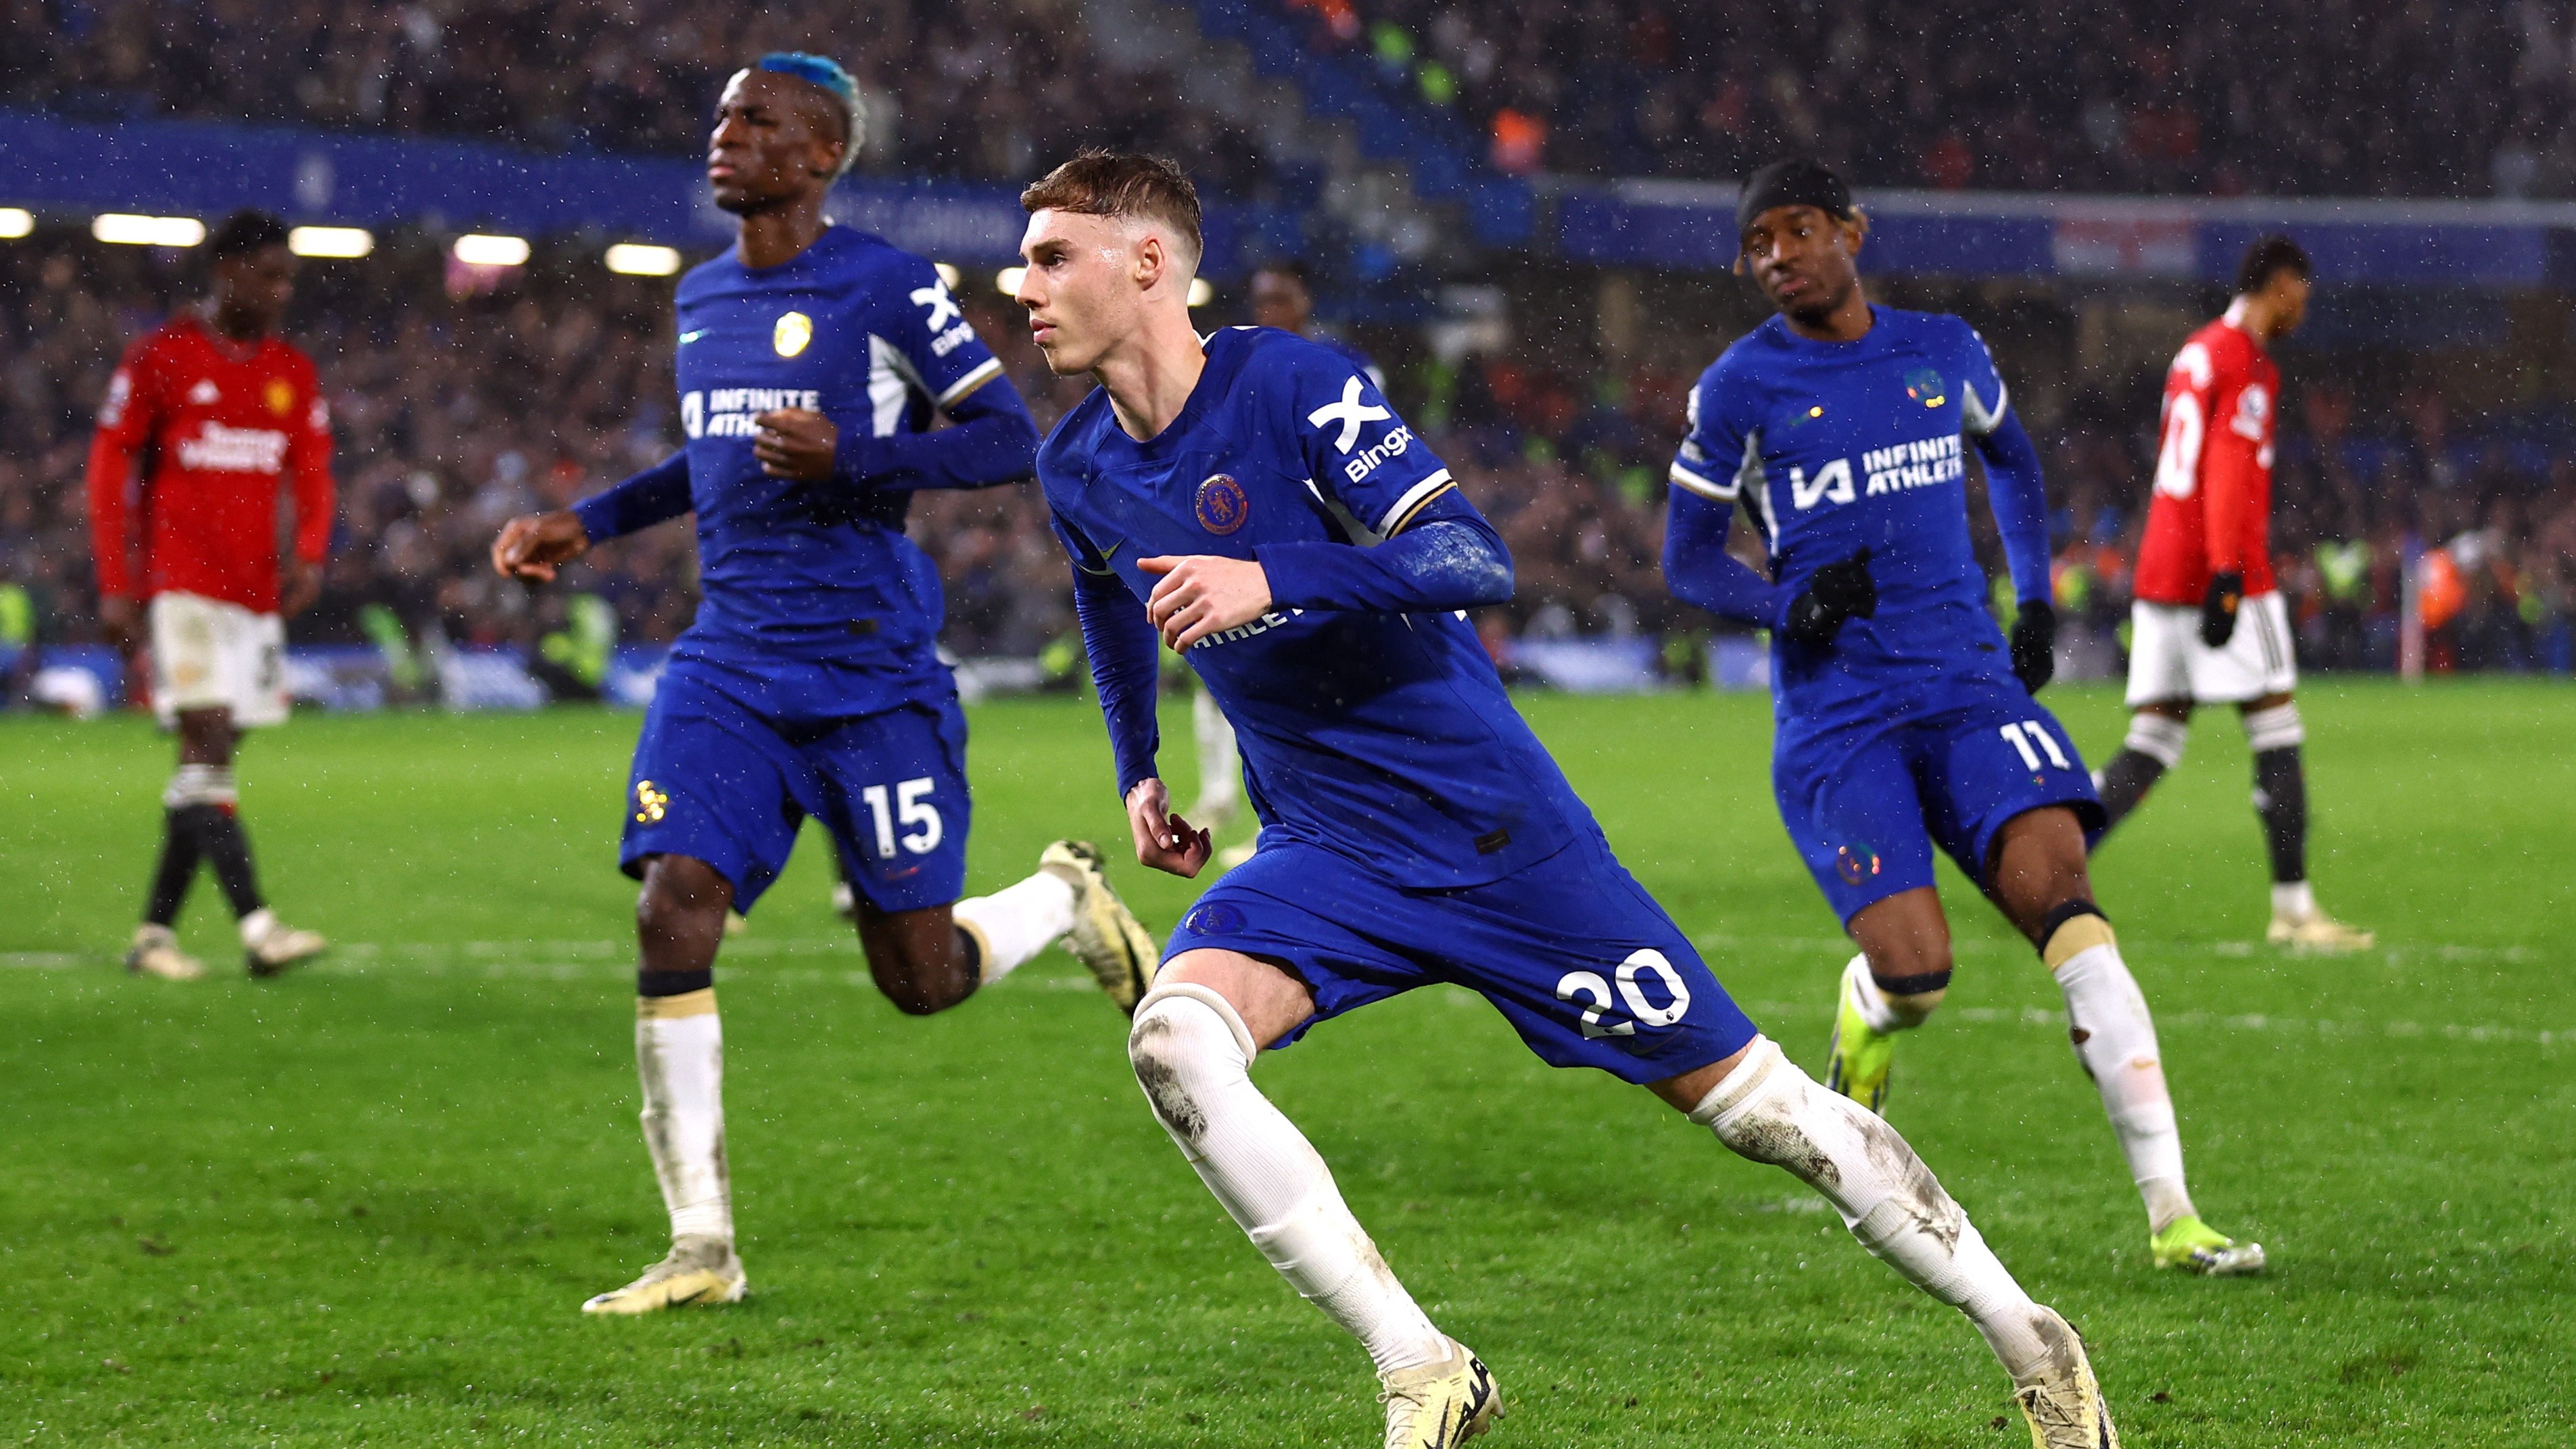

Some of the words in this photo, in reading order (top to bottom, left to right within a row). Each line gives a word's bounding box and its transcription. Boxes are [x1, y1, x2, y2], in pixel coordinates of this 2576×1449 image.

[710, 387, 821, 414] INFINITE
[1999, 720, 2070, 771] 11
[863, 776, 943, 859] 15
[1556, 949, 1690, 1041] 20
